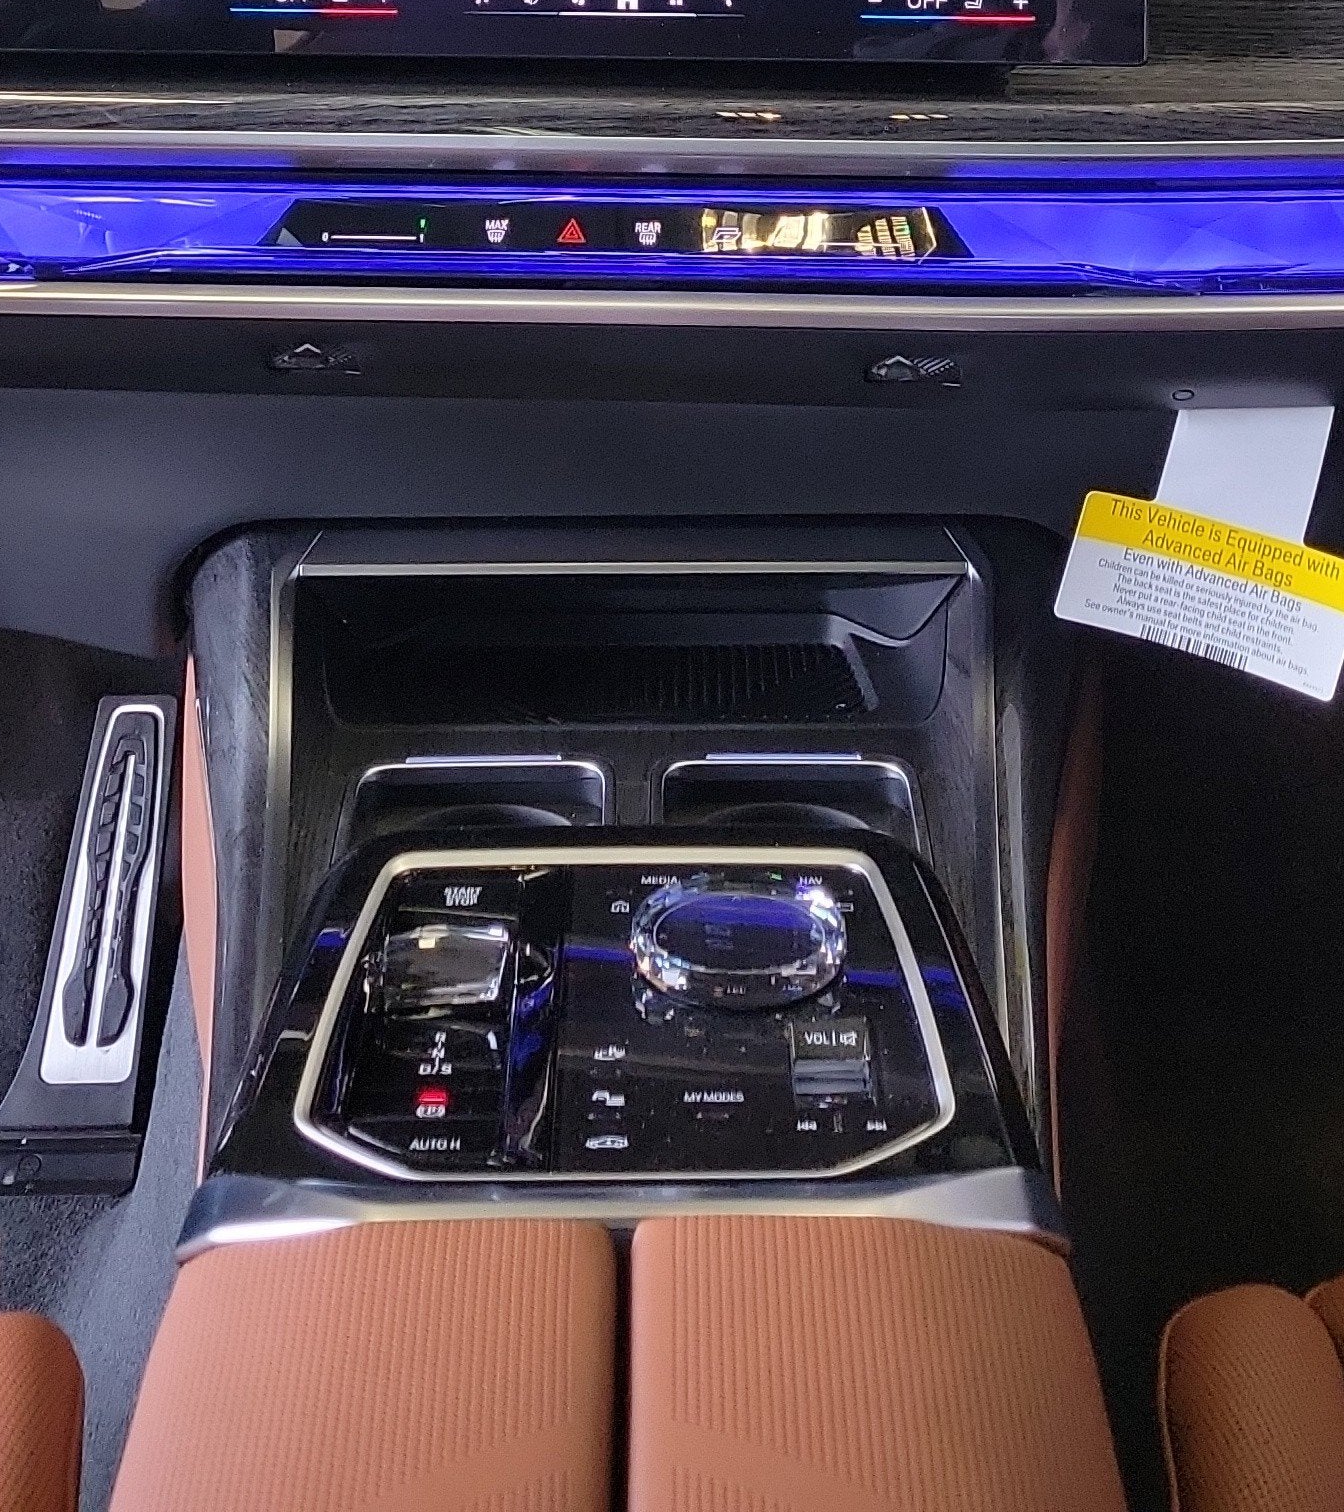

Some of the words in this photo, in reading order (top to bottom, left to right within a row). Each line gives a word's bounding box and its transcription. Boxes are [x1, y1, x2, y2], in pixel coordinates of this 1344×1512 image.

[485, 219, 509, 231] MAX
[635, 221, 661, 234] REAR
[1111, 498, 1143, 521] This
[1148, 506, 1205, 537] Vehicle
[1209, 524, 1222, 543] is
[1226, 529, 1305, 567] Equipped
[1307, 557, 1341, 581] with
[1142, 529, 1223, 565] Advanced
[1225, 552, 1250, 573] Air
[1253, 559, 1293, 588] Bags
[1098, 557, 1132, 575] Children
[1134, 568, 1149, 578] can
[1150, 570, 1161, 582] be
[1162, 574, 1185, 588] killed
[1185, 582, 1195, 590] or
[1196, 584, 1233, 603] seriously
[1233, 593, 1263, 611] injured
[1263, 604, 1273, 618] by
[1275, 608, 1289, 621] the
[1117, 573, 1132, 584] The
[1134, 577, 1152, 590] back
[1154, 585, 1173, 597] seat
[1182, 591, 1196, 602] the
[1223, 602, 1246, 619] place
[1248, 609, 1259, 621] for
[1123, 547, 1155, 567] Even
[1157, 558, 1183, 575] with
[1185, 564, 1249, 594] Advanced
[1249, 582, 1268, 600] Air
[1270, 589, 1302, 612] Bags
[1084, 598, 1100, 609] See
[1136, 612, 1167, 627] manual
[1167, 619, 1178, 630] for
[1179, 624, 1201, 636] more
[1251, 647, 1275, 664] about
[1113, 583, 1137, 597] Never
[1138, 590, 1152, 601] put
[1206, 610, 1227, 624] child
[1228, 616, 1246, 630] seat
[1257, 624, 1270, 638] the
[1116, 595, 1145, 611] Always
[1147, 605, 1161, 615] use
[1163, 608, 1181, 620] seat
[1182, 613, 1202, 626] belts
[1204, 619, 1221, 632] and
[1221, 627, 1242, 640] child
[640, 875, 678, 886] MEDIA
[799, 875, 822, 886] NAV
[805, 1031, 830, 1045] VOL
[683, 1091, 702, 1102] MY
[702, 1090, 745, 1103] MODES
[409, 1137, 447, 1150] AUTO
